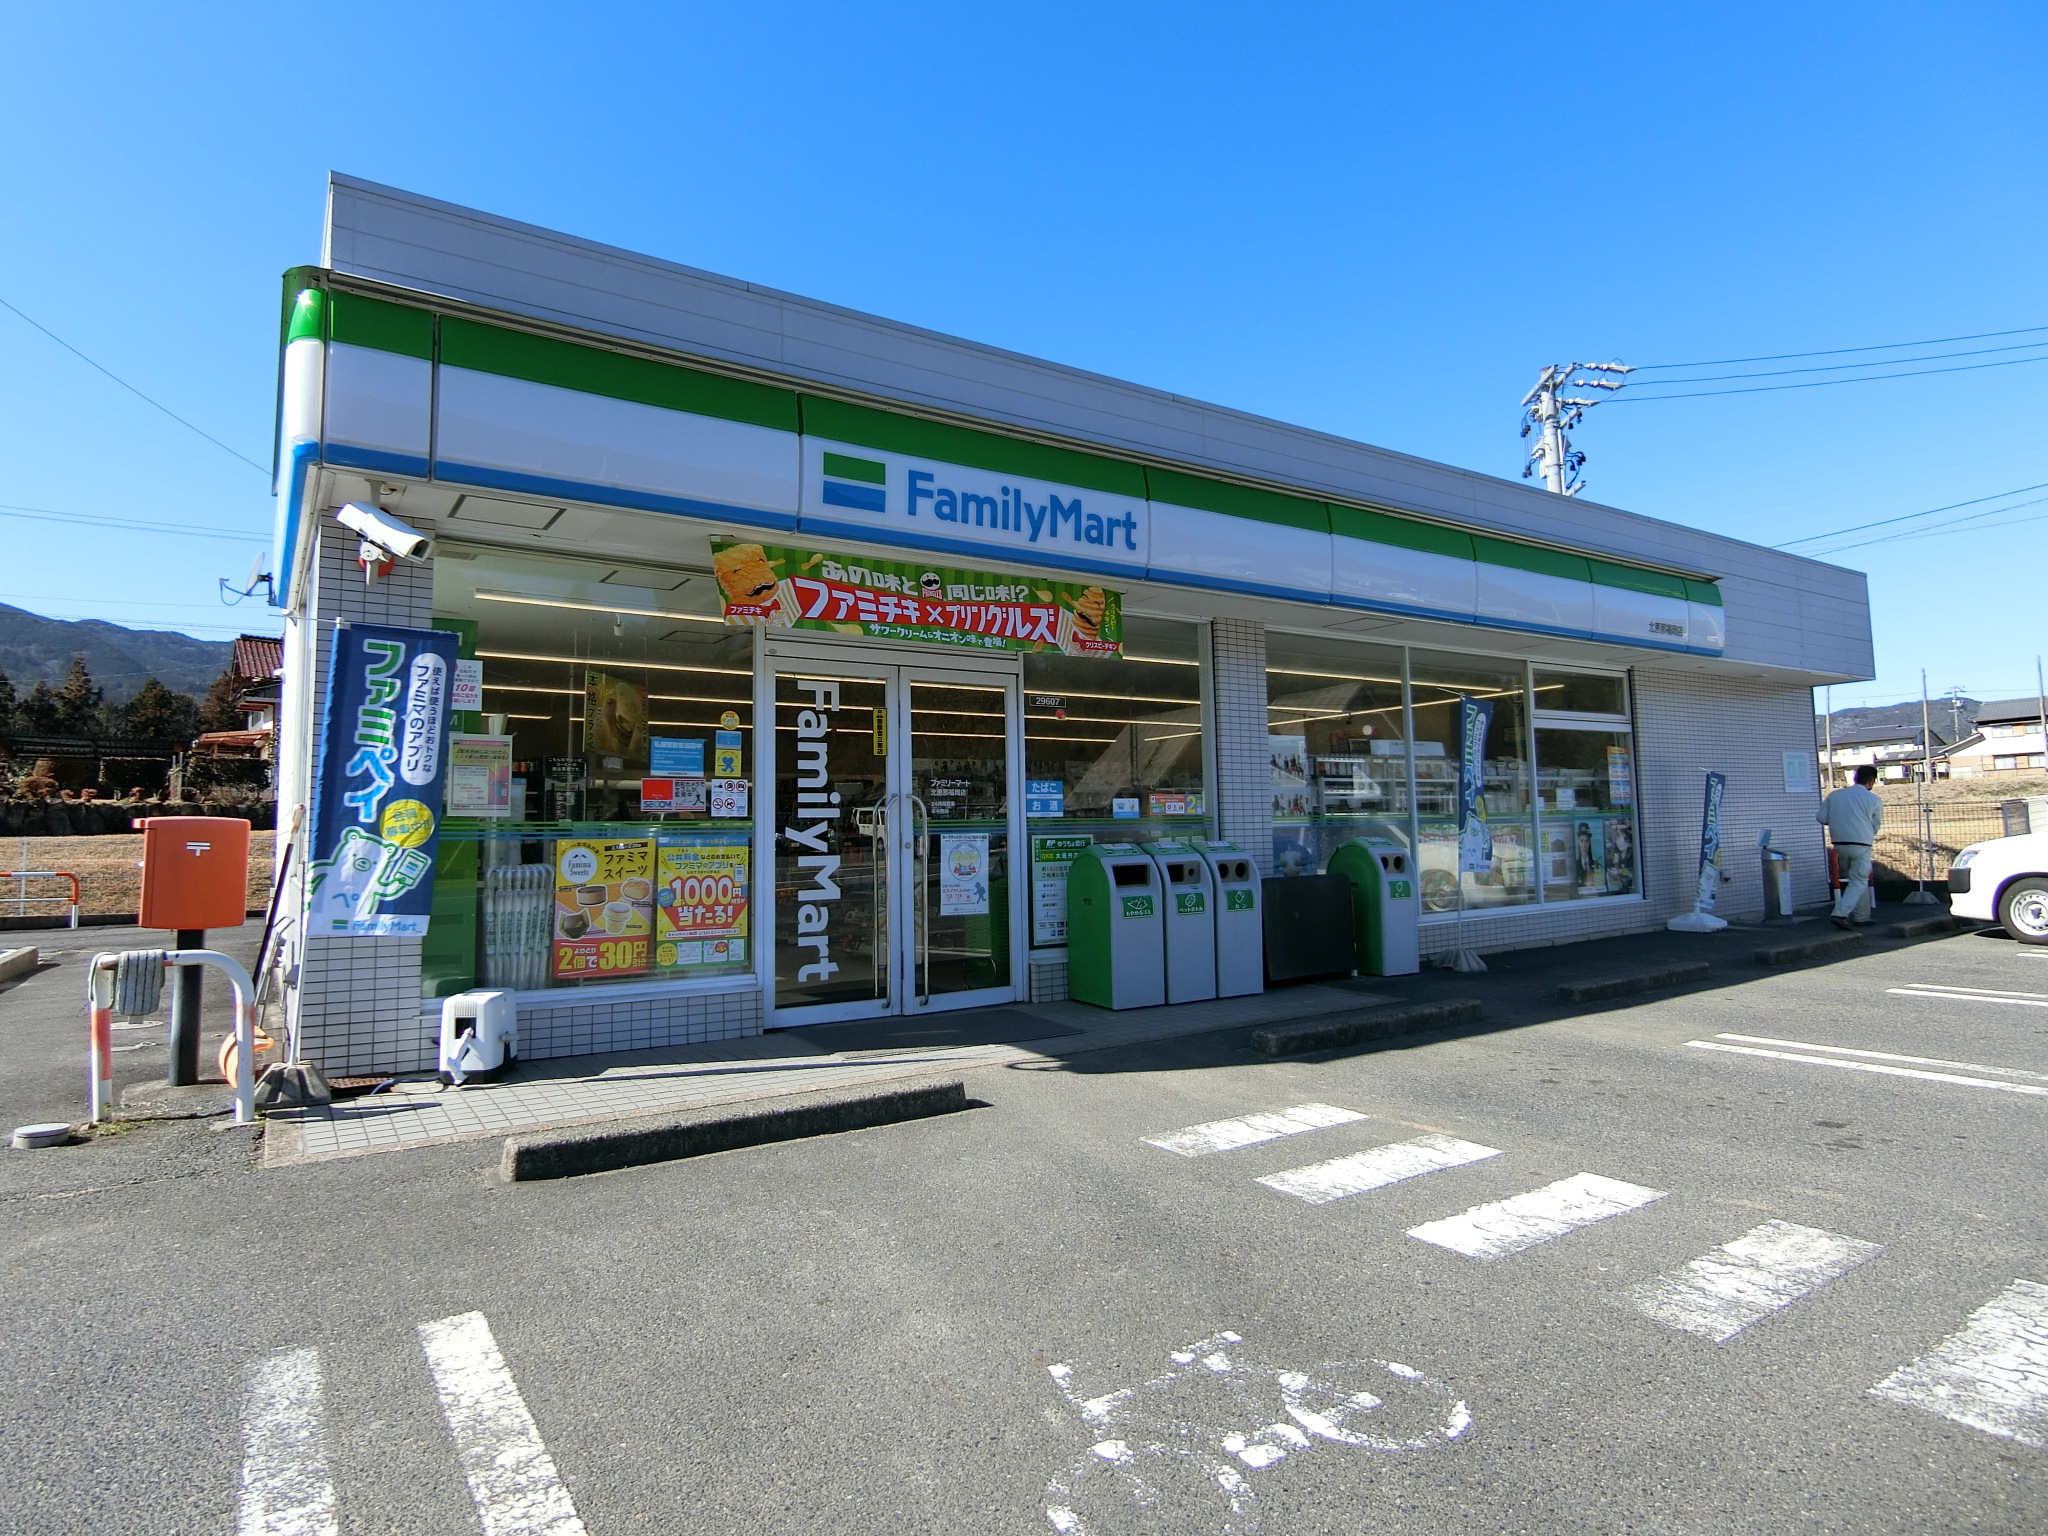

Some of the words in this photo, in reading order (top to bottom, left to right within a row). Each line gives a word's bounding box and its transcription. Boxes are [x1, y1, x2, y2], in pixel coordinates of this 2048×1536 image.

[907, 468, 1137, 552] FamilyMart
[821, 559, 919, 596] あの味と
[946, 583, 1029, 603] 同じ味!?
[730, 606, 762, 615] ファミチキ
[1085, 641, 1117, 650] クリスピーチキン
[1035, 697, 1060, 706] 29607
[407, 665, 430, 772] ファミマのアプリ
[422, 666, 442, 772] 使えば使うほどおトクな
[345, 639, 405, 822] ファミペイ
[930, 779, 972, 787] ファミリーマート
[1031, 782, 1057, 793] たばこ
[785, 680, 841, 983] FamilyMart
[568, 860, 591, 869] Famima
[604, 851, 648, 865] ファミマ
[569, 868, 590, 876] Sweets
[603, 865, 648, 880] スイーツ
[677, 905, 733, 926] 当たる!
[352, 920, 416, 932] FamilyMart
[558, 947, 598, 969] 2個で
[574, 947, 596, 955] よりとり
